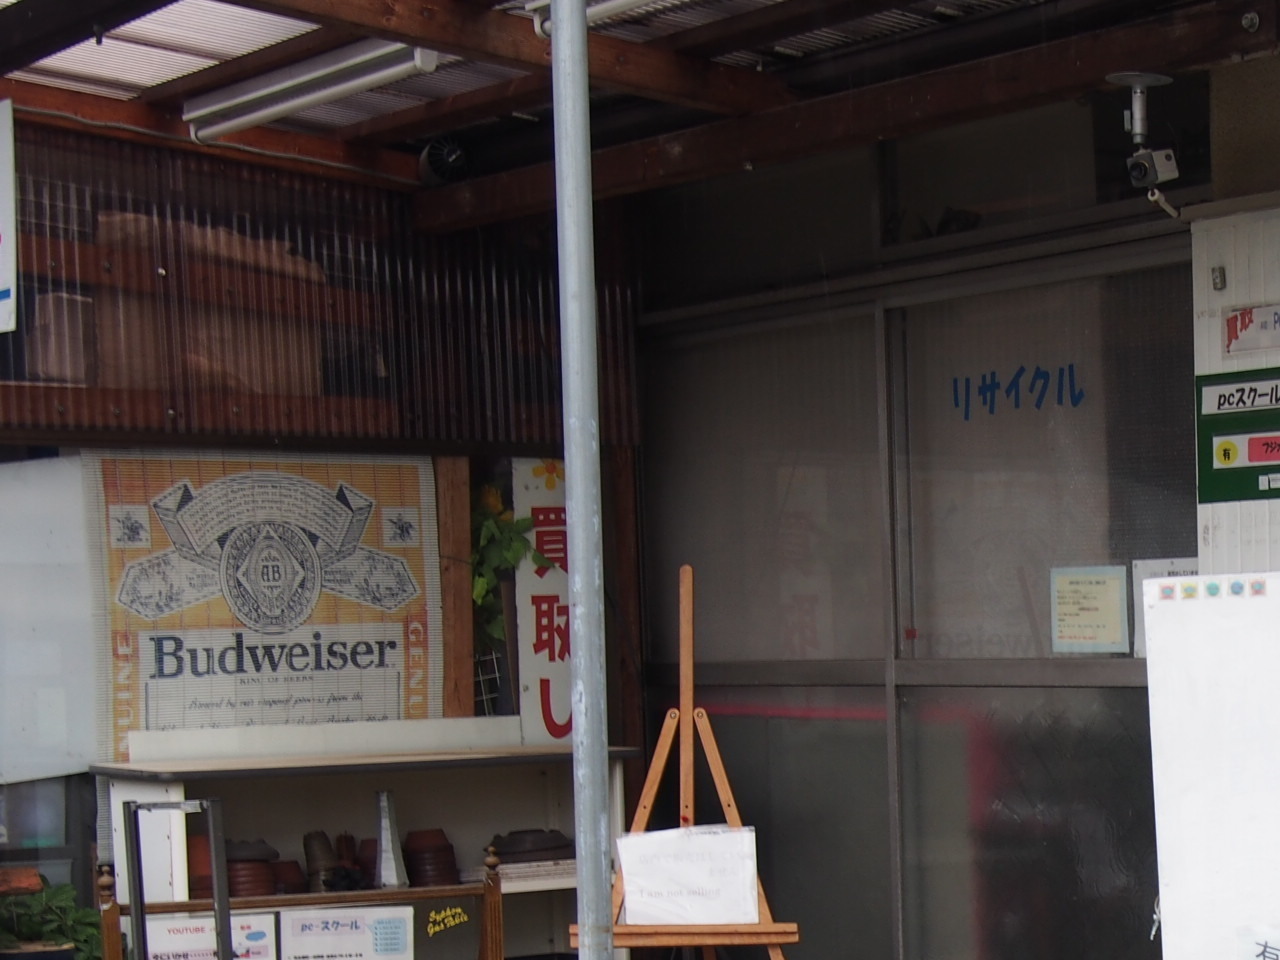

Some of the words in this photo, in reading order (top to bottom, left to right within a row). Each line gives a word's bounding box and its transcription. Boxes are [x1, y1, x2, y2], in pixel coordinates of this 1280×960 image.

[952, 363, 1085, 421] リサイクル
[260, 564, 282, 583] AB
[149, 631, 398, 679] Budweiser
[167, 926, 206, 936] YOUTUBE
